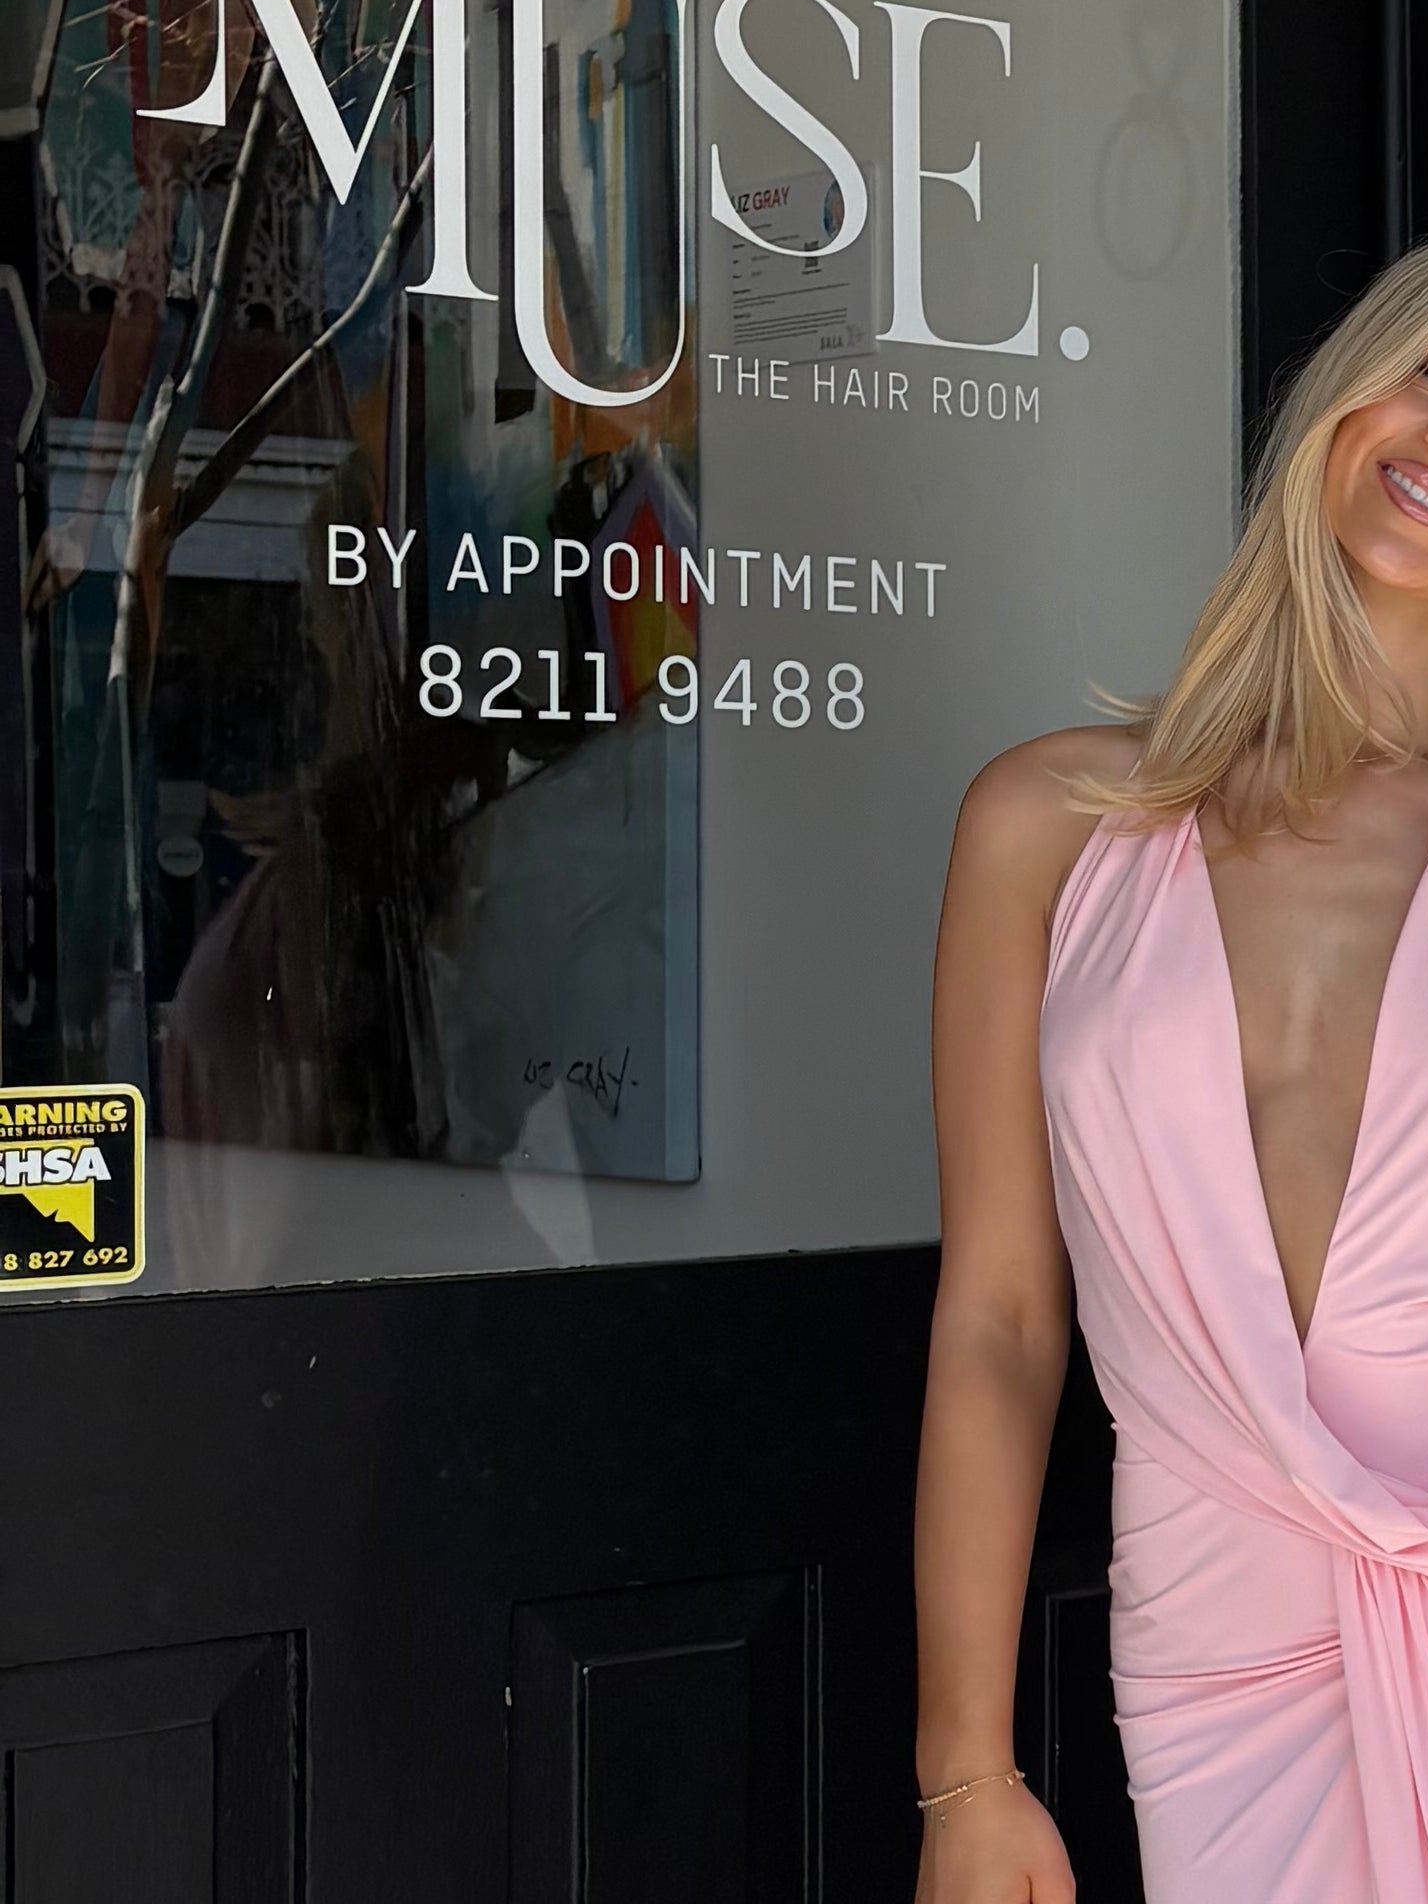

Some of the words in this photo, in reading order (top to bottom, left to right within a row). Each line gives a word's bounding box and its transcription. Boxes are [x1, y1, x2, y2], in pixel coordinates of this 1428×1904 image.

[752, 186, 790, 211] GRAY
[709, 354, 790, 401] THE
[812, 365, 910, 412] HAIR
[934, 375, 1041, 424] ROOM
[326, 523, 418, 589] BY
[446, 532, 948, 618] APPOINTMENT
[417, 644, 618, 723] 8211
[656, 657, 867, 730] 9488
[28, 1123, 106, 1135] PROTECTED
[110, 1122, 128, 1132] BY
[28, 1250, 74, 1270] 827
[83, 1246, 128, 1266] 692
